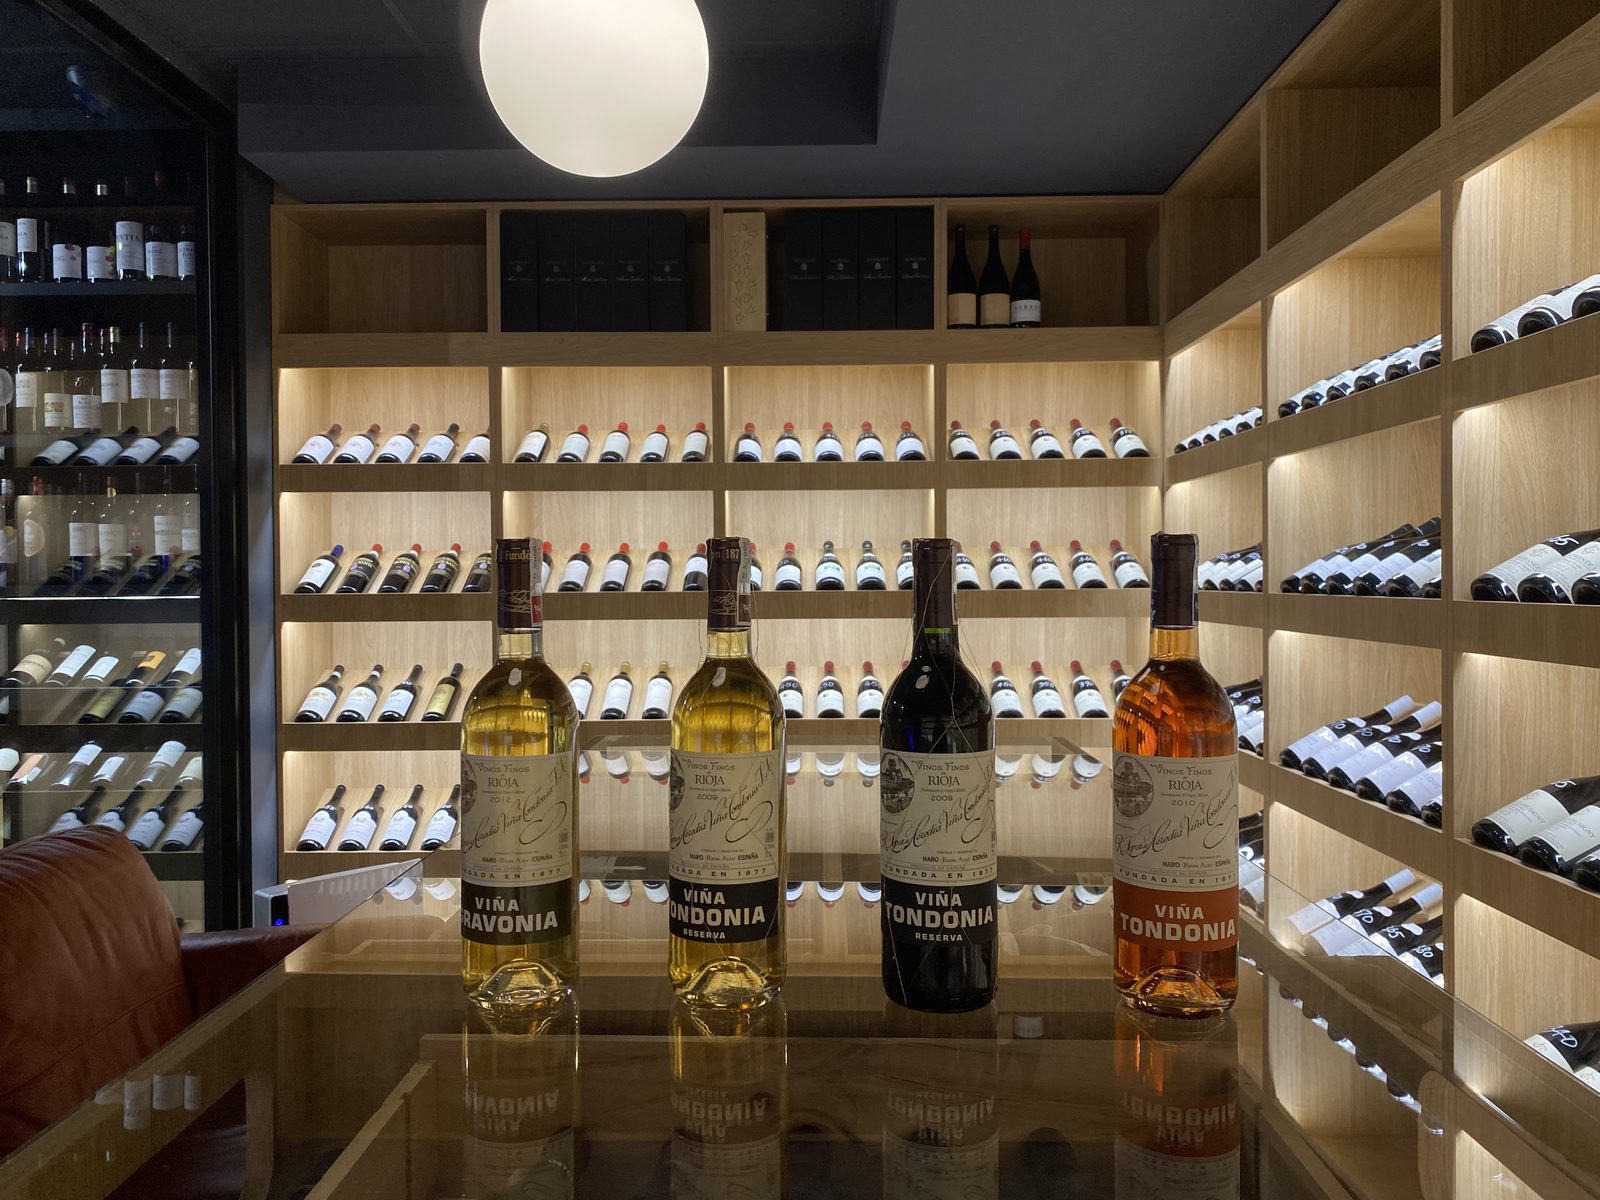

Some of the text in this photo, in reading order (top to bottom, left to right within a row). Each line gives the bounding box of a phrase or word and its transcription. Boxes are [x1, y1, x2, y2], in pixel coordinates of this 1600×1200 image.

[488, 777, 519, 788] RIOJA
[695, 775, 725, 787] RIOJA
[928, 775, 961, 787] RIOJA
[1168, 779, 1203, 792] RIOJA
[697, 793, 718, 801] 2009
[1171, 799, 1196, 807] 2010
[531, 868, 561, 879] 1877
[738, 867, 767, 877] 1877
[884, 863, 937, 879] FUNDADA
[972, 866, 994, 878] 1877
[1119, 868, 1178, 884] FUNDADA
[683, 888, 726, 905] VIÑA
[915, 890, 963, 907] VIÑA
[475, 896, 520, 912] VIÑA
[669, 900, 766, 927] ONDONIA
[885, 901, 994, 929] TONDONIA
[1154, 903, 1205, 919] VIÑA
[1120, 912, 1236, 942] TONDONIA
[683, 928, 726, 940] RESERVA
[915, 932, 963, 942] RESERVA
